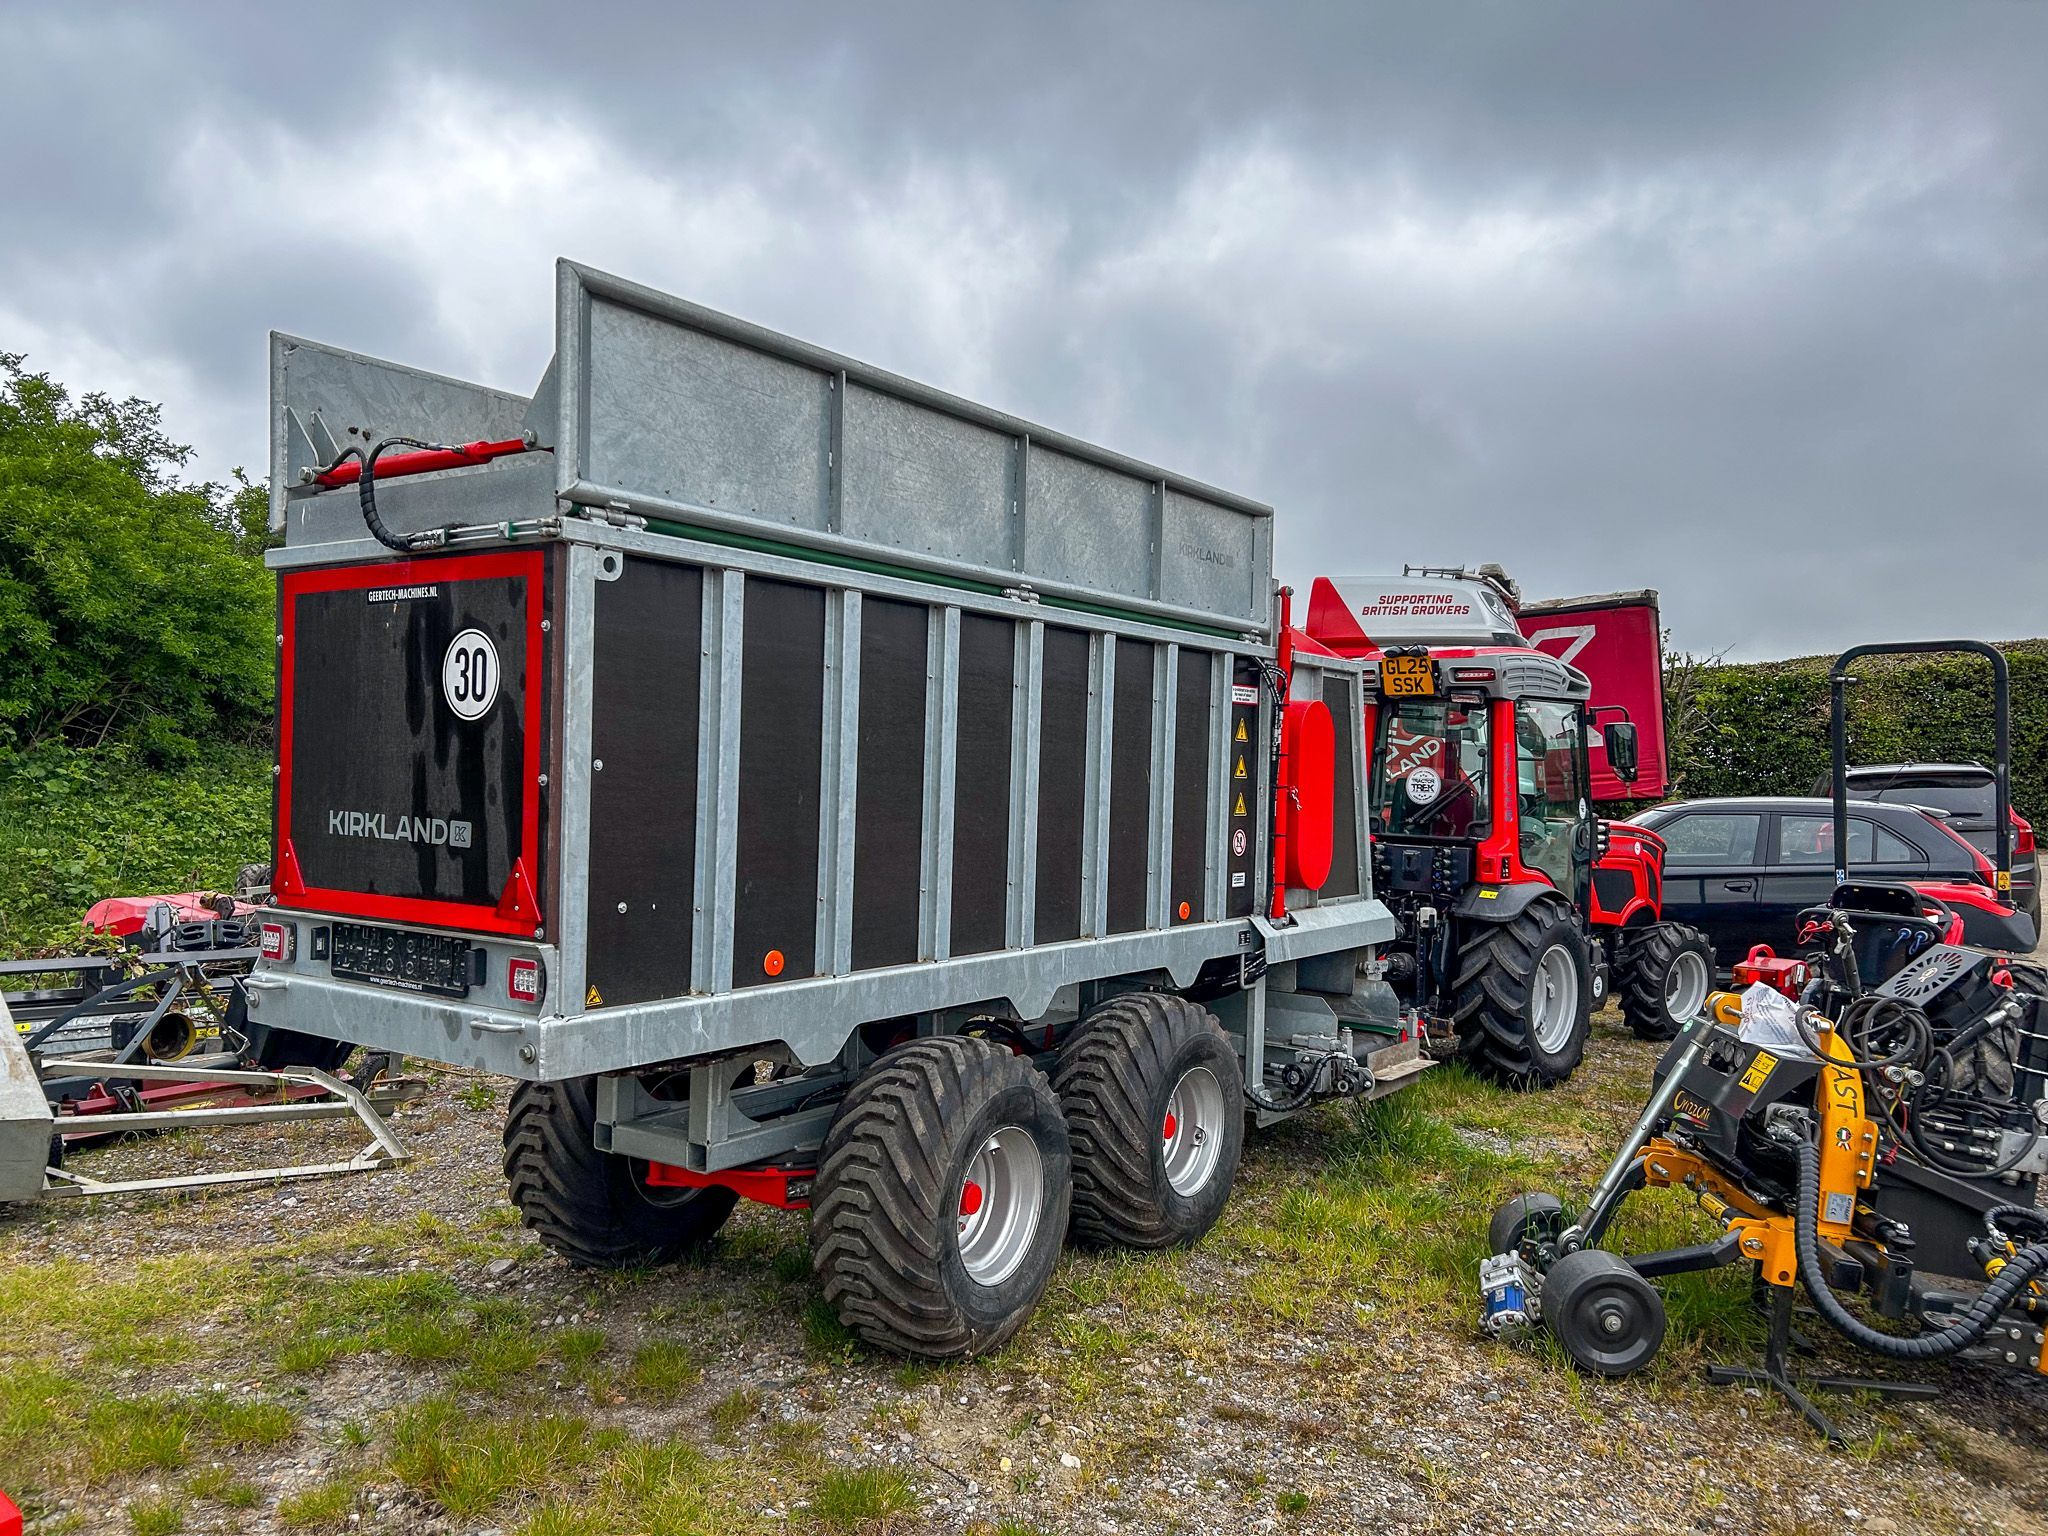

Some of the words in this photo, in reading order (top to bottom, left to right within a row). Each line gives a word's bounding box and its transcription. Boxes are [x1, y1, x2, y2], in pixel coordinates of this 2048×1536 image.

[368, 586, 438, 602] GEERTECH-MACHINES.NL
[1378, 594, 1453, 605] SUPPORTING
[1361, 606, 1408, 616] BRITISH
[1411, 605, 1470, 615] GROWERS
[1385, 658, 1429, 675] GL25
[454, 647, 487, 703] 30
[1393, 677, 1425, 693] SSK
[1411, 783, 1435, 793] TREK
[328, 809, 448, 845] KIRKLAND
[369, 976, 423, 990] www.geertech-machines.nl
